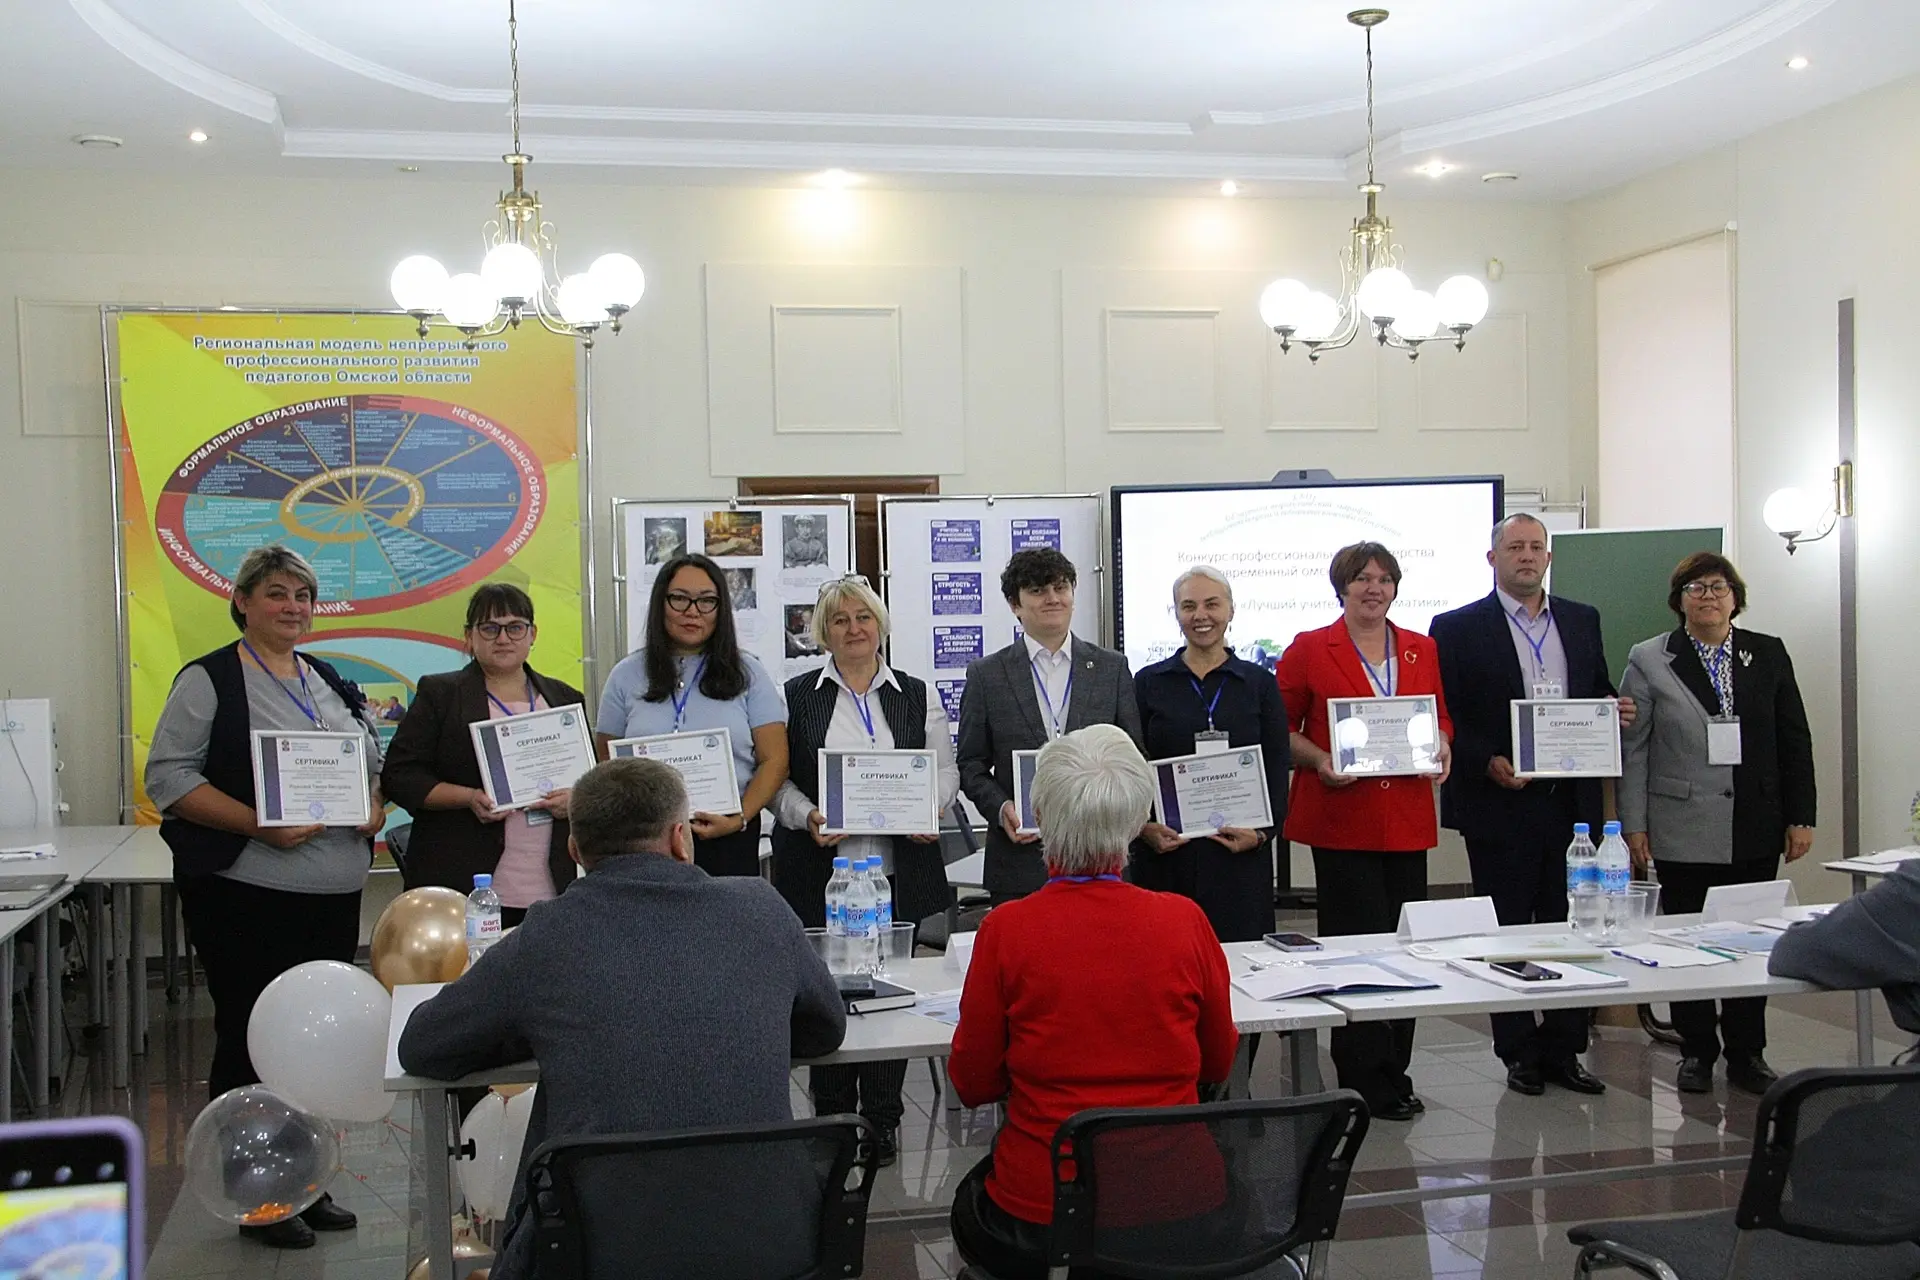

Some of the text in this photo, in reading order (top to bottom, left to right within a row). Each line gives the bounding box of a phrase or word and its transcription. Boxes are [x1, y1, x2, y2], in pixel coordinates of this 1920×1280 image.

[194, 336, 314, 350] Региональная
[320, 339, 383, 351] модель
[225, 353, 480, 369] профессионального развития
[245, 369, 472, 384] педагогов Омской области
[340, 412, 349, 424] 3
[400, 413, 410, 425] 4
[283, 424, 292, 436] 2
[178, 422, 254, 478] ФОРМАЛЬНОЕ
[255, 396, 349, 426] ОБРАЗОВАНИЕ
[467, 434, 477, 446] 5
[226, 453, 233, 464] 1
[452, 405, 535, 475] НЕФОРМАЛЬНОЕ
[504, 475, 541, 557] ОБРАЗОВАНИЕ
[508, 491, 517, 503] 6
[157, 527, 237, 594] ИНФОРМАЛЬН
[1178, 551, 1229, 564] Конкурс
[1549, 720, 1594, 728] СЕРТИФИКАТ
[516, 732, 562, 748] СЕРТИФИКАТ
[294, 757, 341, 767] СЕРТИФИКАТ
[860, 772, 909, 781] СЕРТИФИКАТ
[1191, 771, 1239, 785] СЕРТИФИКАТ
